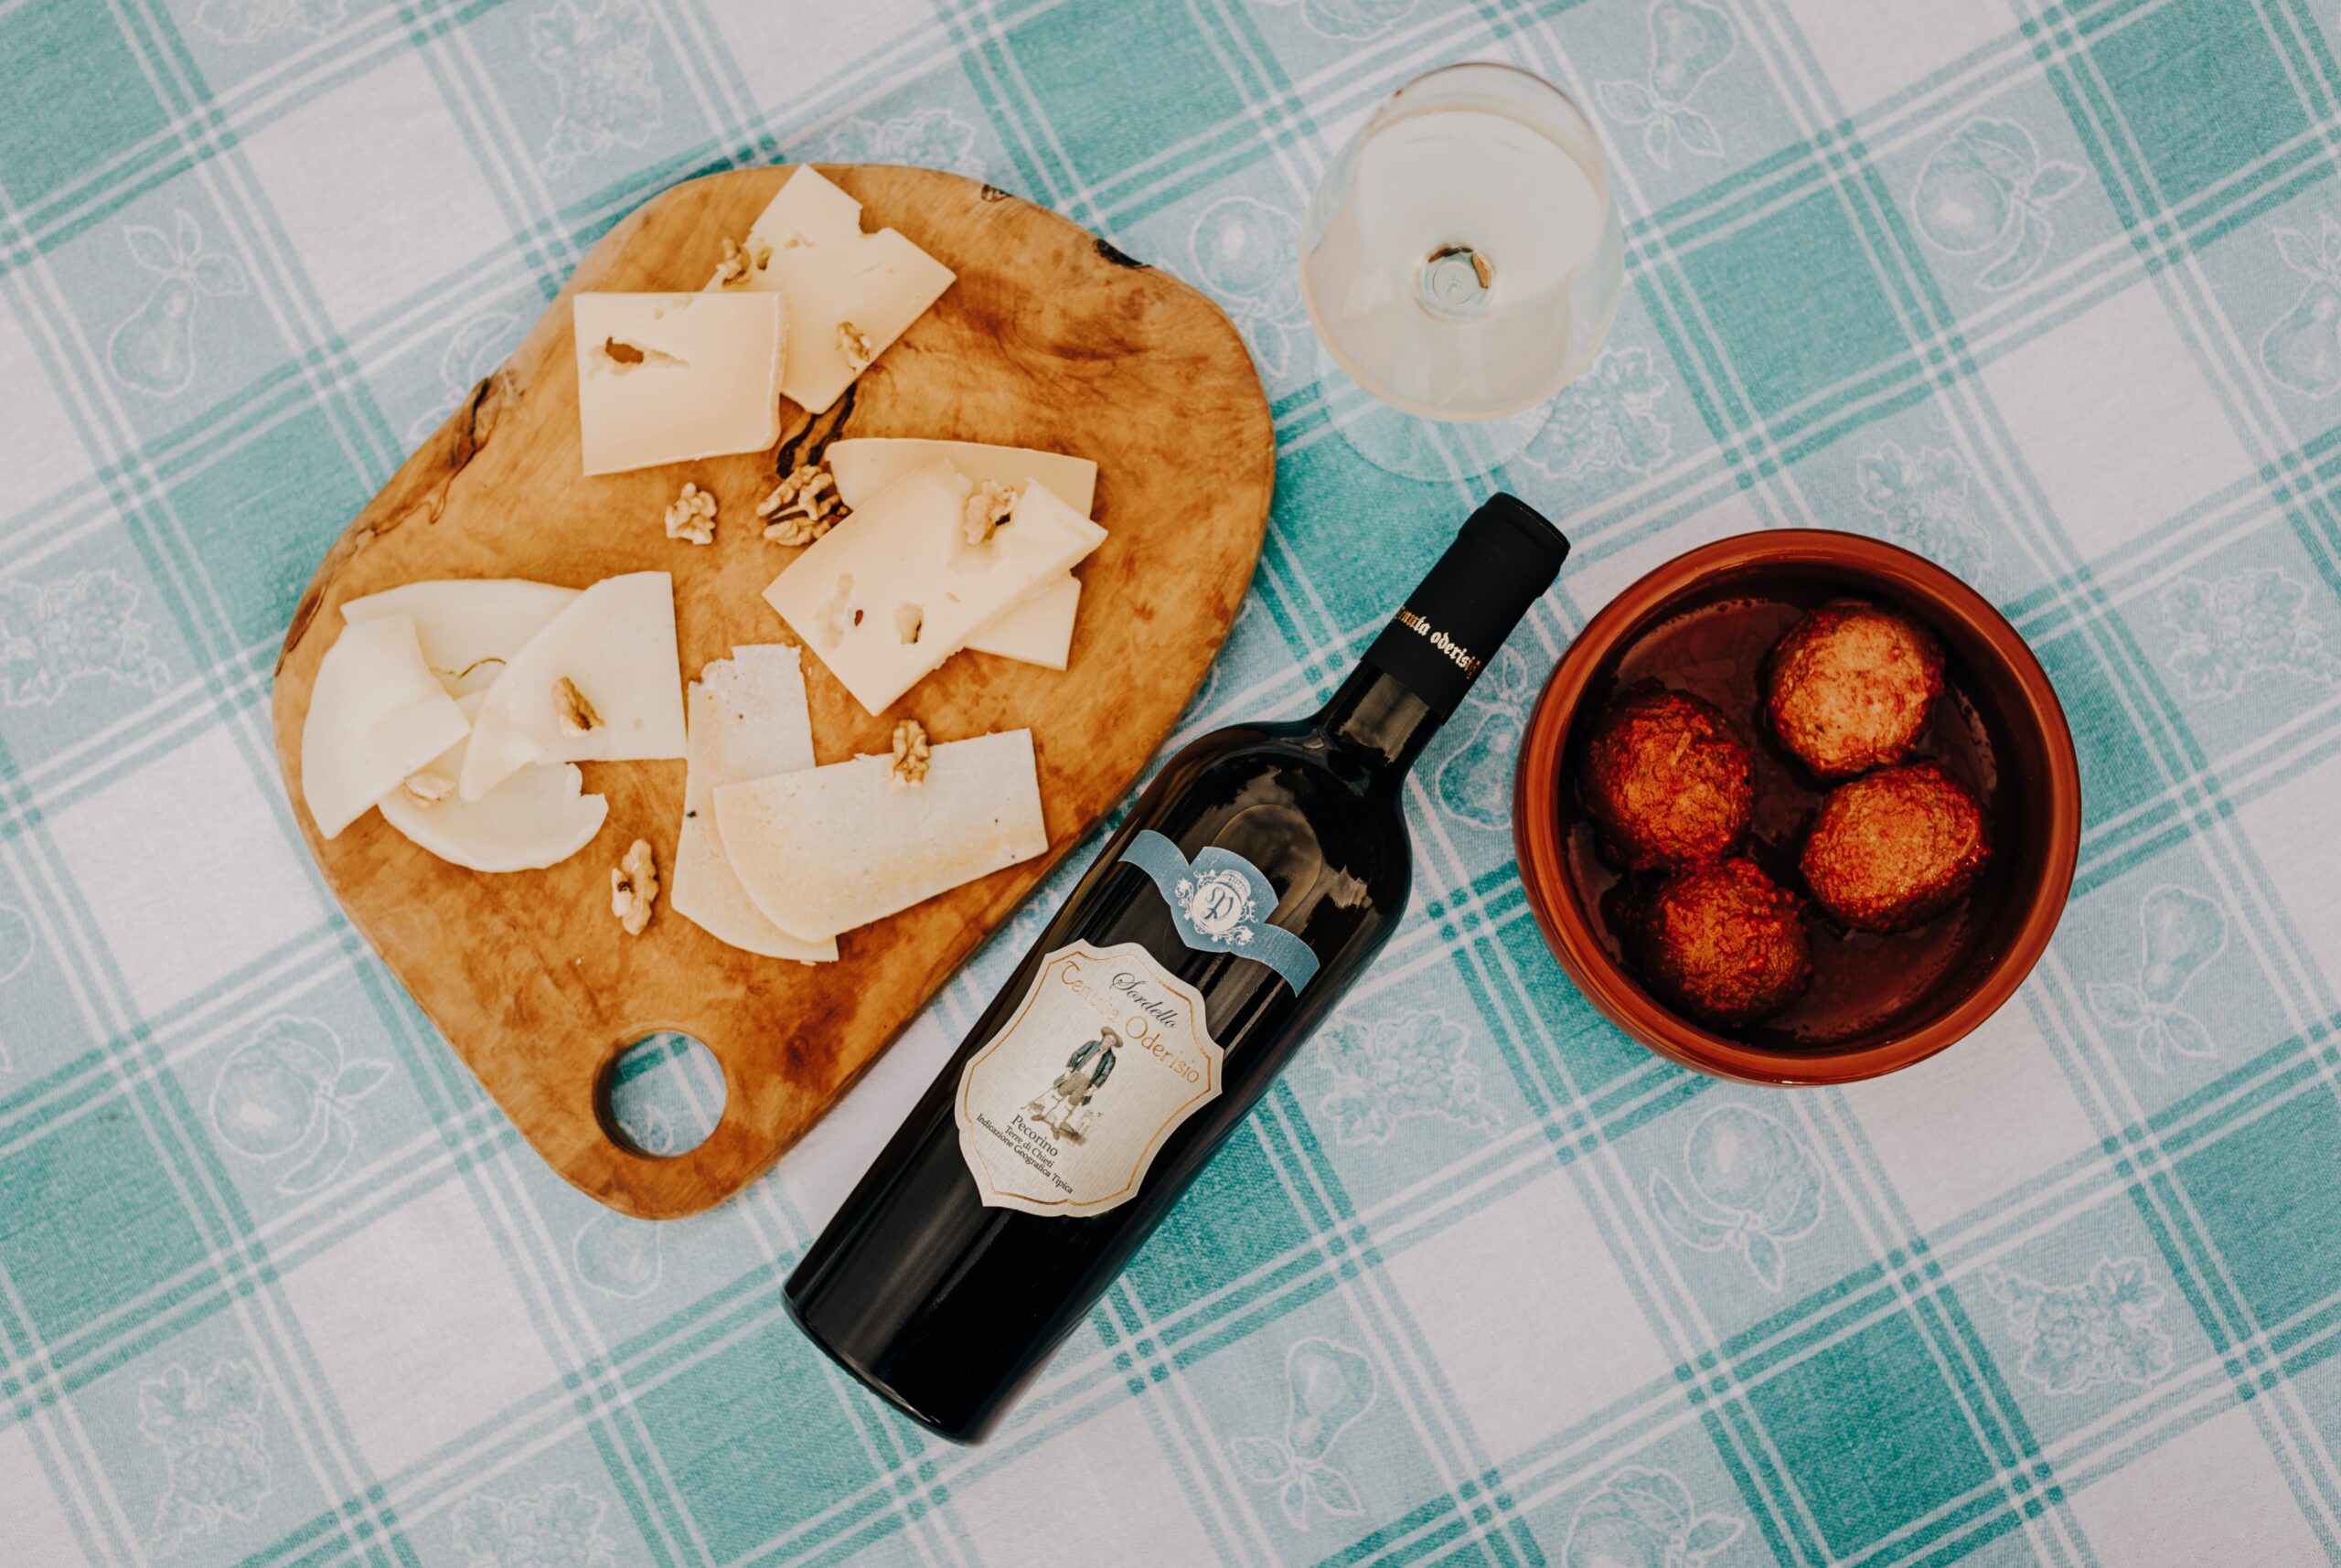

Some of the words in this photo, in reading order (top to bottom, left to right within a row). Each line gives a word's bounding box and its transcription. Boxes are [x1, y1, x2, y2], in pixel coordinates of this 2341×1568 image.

[1109, 972, 1178, 1029] Sordello
[1126, 1016, 1200, 1083] Oderisio
[977, 1114, 1014, 1148] Indicazione
[1013, 1144, 1052, 1178] Geografica
[1052, 1173, 1074, 1194] Tipica
[1005, 1125, 1023, 1144] Terre
[1022, 1141, 1032, 1151] di
[1032, 1147, 1055, 1168] Chieti
[1010, 1114, 1058, 1157] Pecorino
